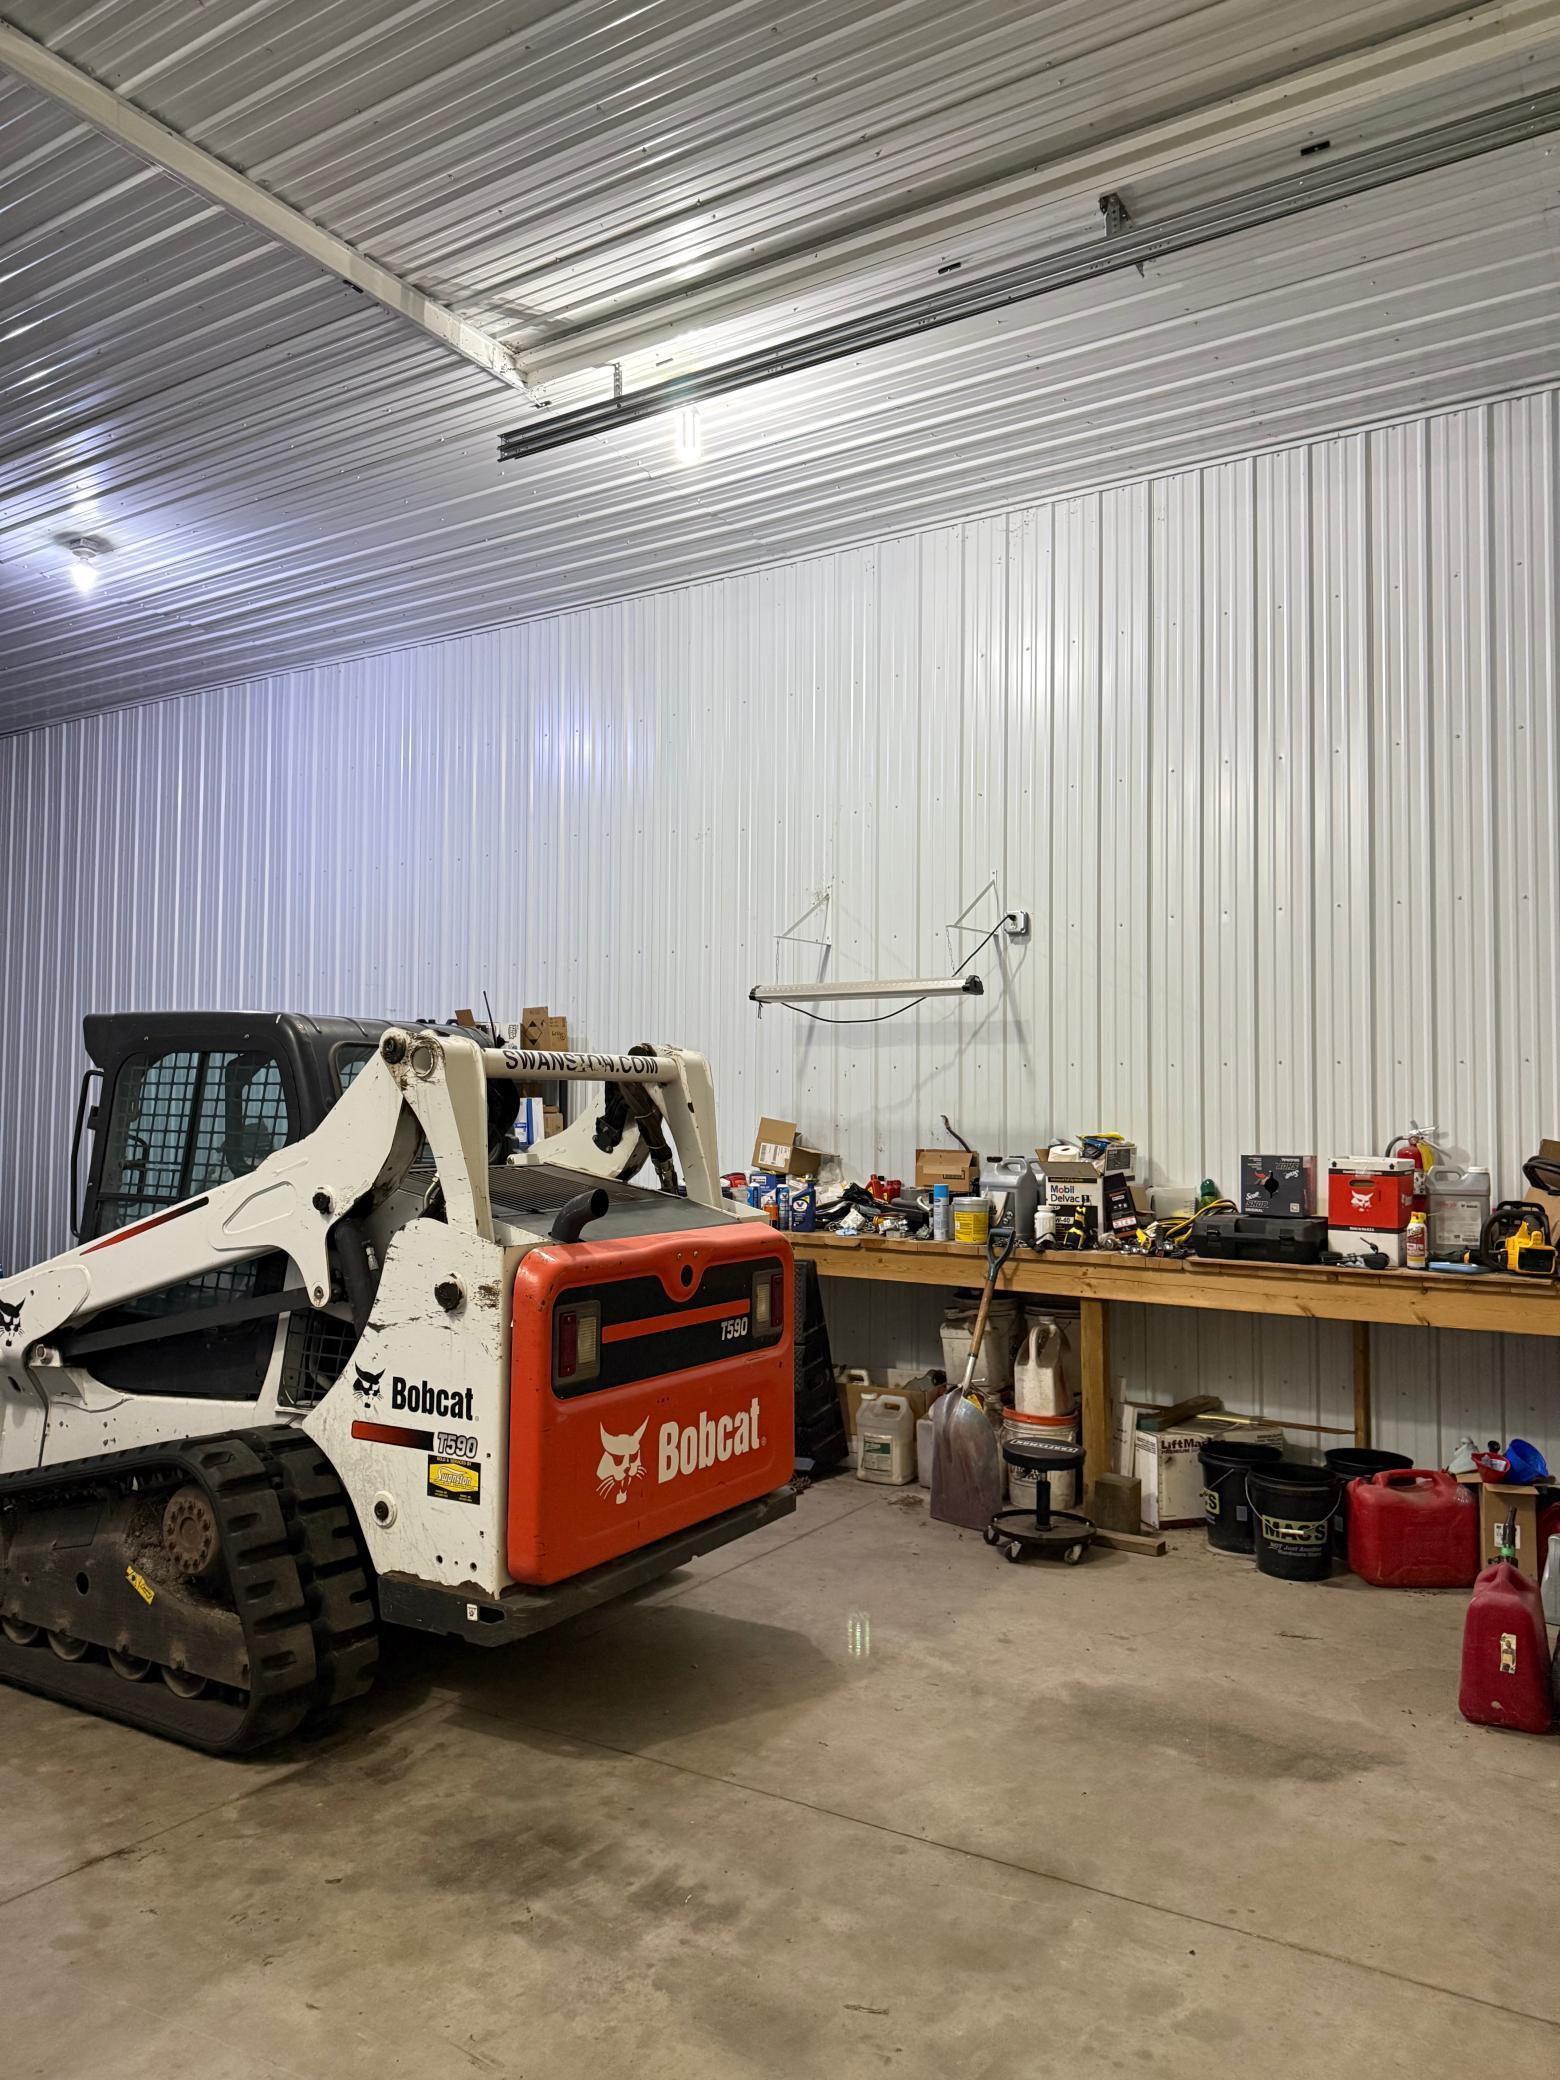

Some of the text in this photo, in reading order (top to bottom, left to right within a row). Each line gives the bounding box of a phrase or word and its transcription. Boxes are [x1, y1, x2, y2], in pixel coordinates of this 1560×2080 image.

[1050, 1184, 1075, 1194] Mobil
[1050, 1194, 1080, 1203] Delvac
[720, 1316, 749, 1341] T590
[391, 1376, 474, 1421] Bobcat
[437, 1432, 478, 1459] T590
[658, 1397, 760, 1484] Bobcat
[1161, 1437, 1227, 1450] LiftMa
